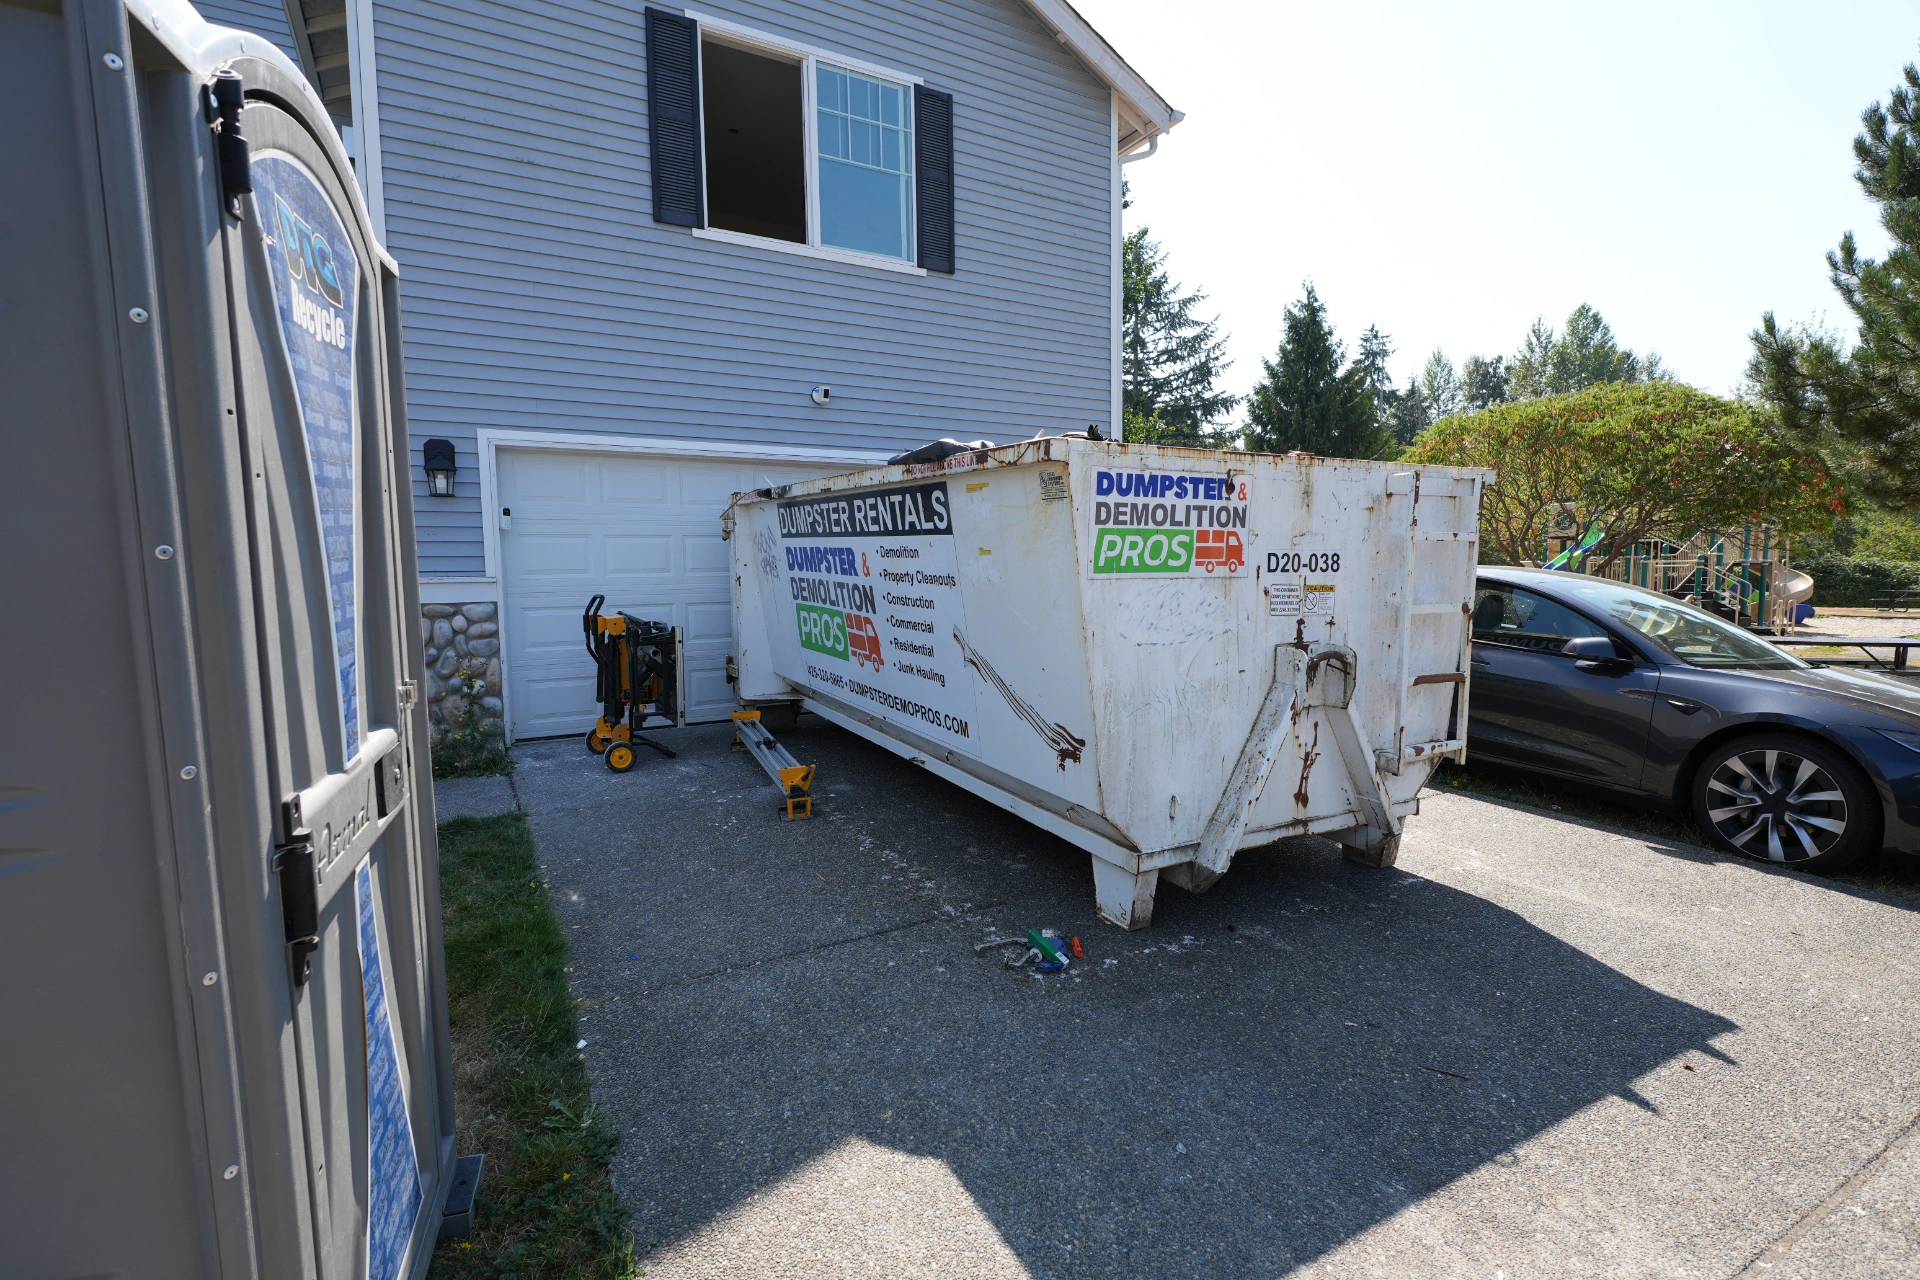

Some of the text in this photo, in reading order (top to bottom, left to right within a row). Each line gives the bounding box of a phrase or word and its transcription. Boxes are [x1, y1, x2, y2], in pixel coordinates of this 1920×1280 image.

[290, 278, 346, 350] Recycle
[953, 456, 965, 469] THIS
[1237, 482, 1248, 501] &
[779, 490, 948, 534] DUMPSTER RENTALS
[1095, 502, 1247, 528] DEMOLITION
[785, 546, 859, 577] DUMPSTER
[861, 551, 871, 577] &
[880, 545, 919, 559] Demolition
[1098, 534, 1190, 567] PROS
[1267, 552, 1340, 574] D20-038
[883, 568, 956, 587] Property Cleanouts
[790, 577, 876, 614] DEMOLITION
[886, 591, 935, 610] Construction
[800, 610, 845, 652] PROS
[890, 615, 934, 634] Commercial
[893, 637, 935, 658] Residential
[898, 660, 945, 687] Junk Hauling
[848, 678, 970, 739] DUMPSTERDEMOPROS.COM
